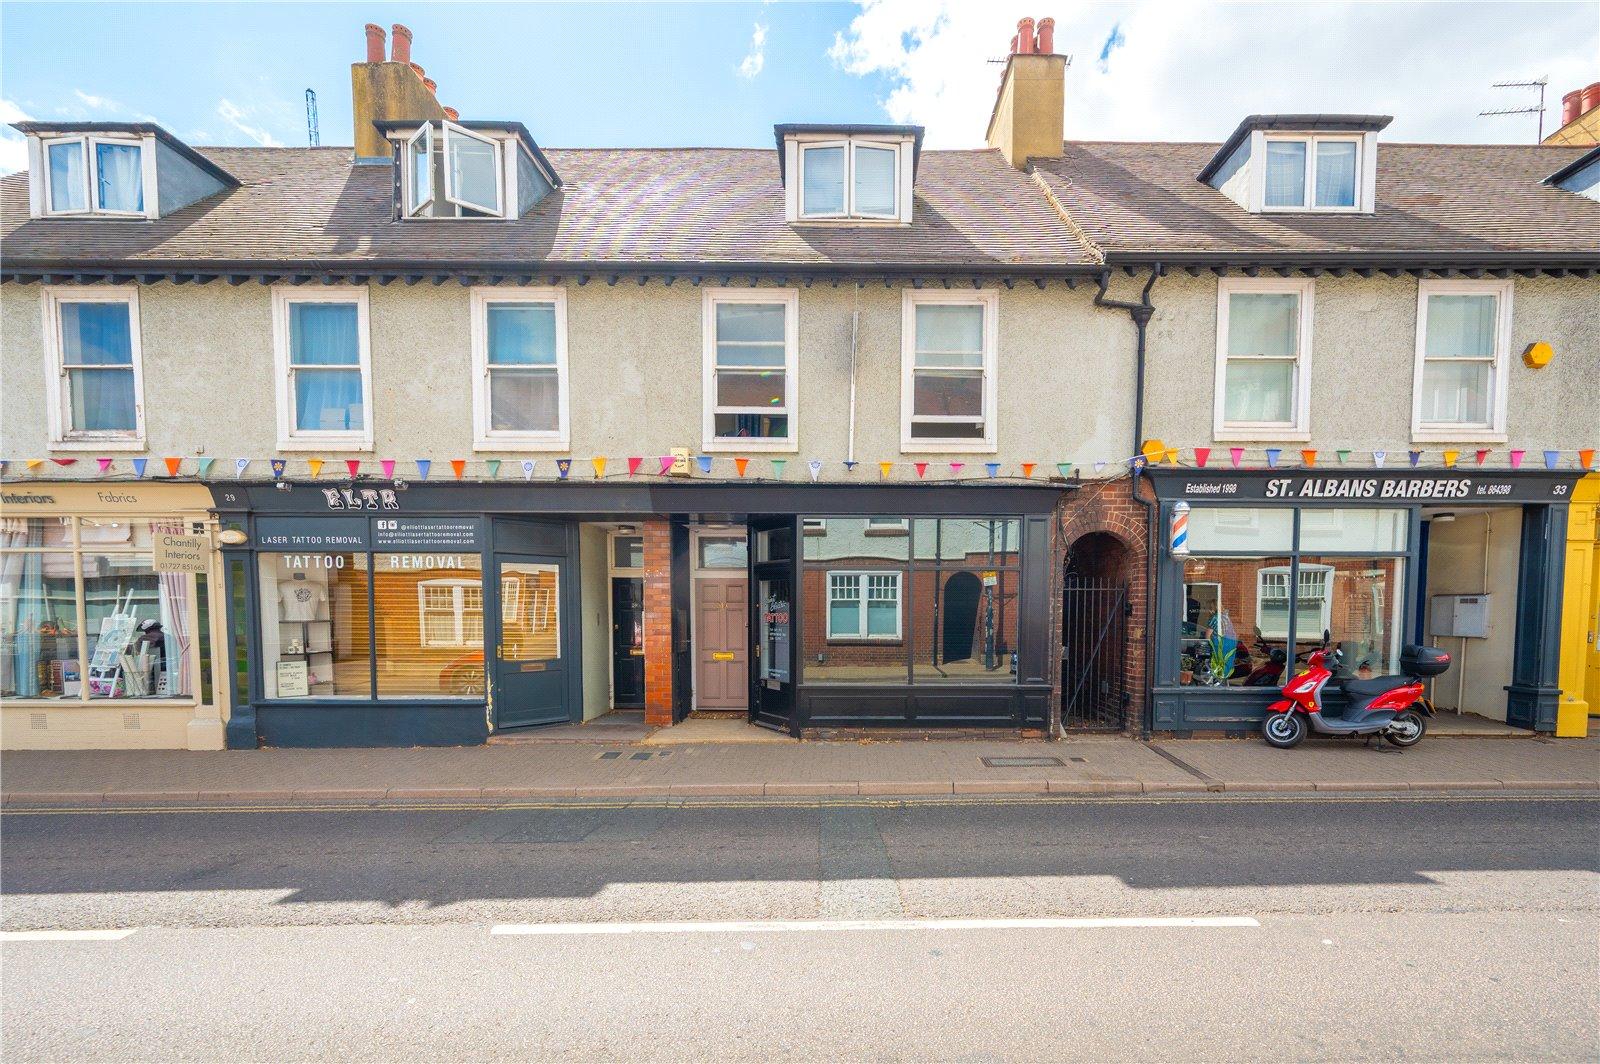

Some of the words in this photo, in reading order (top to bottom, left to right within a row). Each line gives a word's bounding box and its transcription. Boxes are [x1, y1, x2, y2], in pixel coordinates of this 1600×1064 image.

[1185, 483, 1221, 494] Established
[1265, 479, 1294, 498] ST.
[1299, 479, 1377, 498] ALBANS
[1380, 479, 1471, 498] BARBERS
[1552, 485, 1567, 495] 33
[97, 491, 138, 503] Fabrics
[224, 494, 236, 502] 29
[321, 487, 400, 510] ELTR
[163, 536, 202, 550] Chantilly
[261, 536, 288, 544] LASER
[292, 536, 322, 544] TATTOO
[325, 536, 363, 544] REMOVAL
[165, 549, 201, 560] Interiors
[160, 562, 181, 570] 01727
[283, 555, 345, 570] TATTOO
[390, 556, 466, 570] REMOVAL
